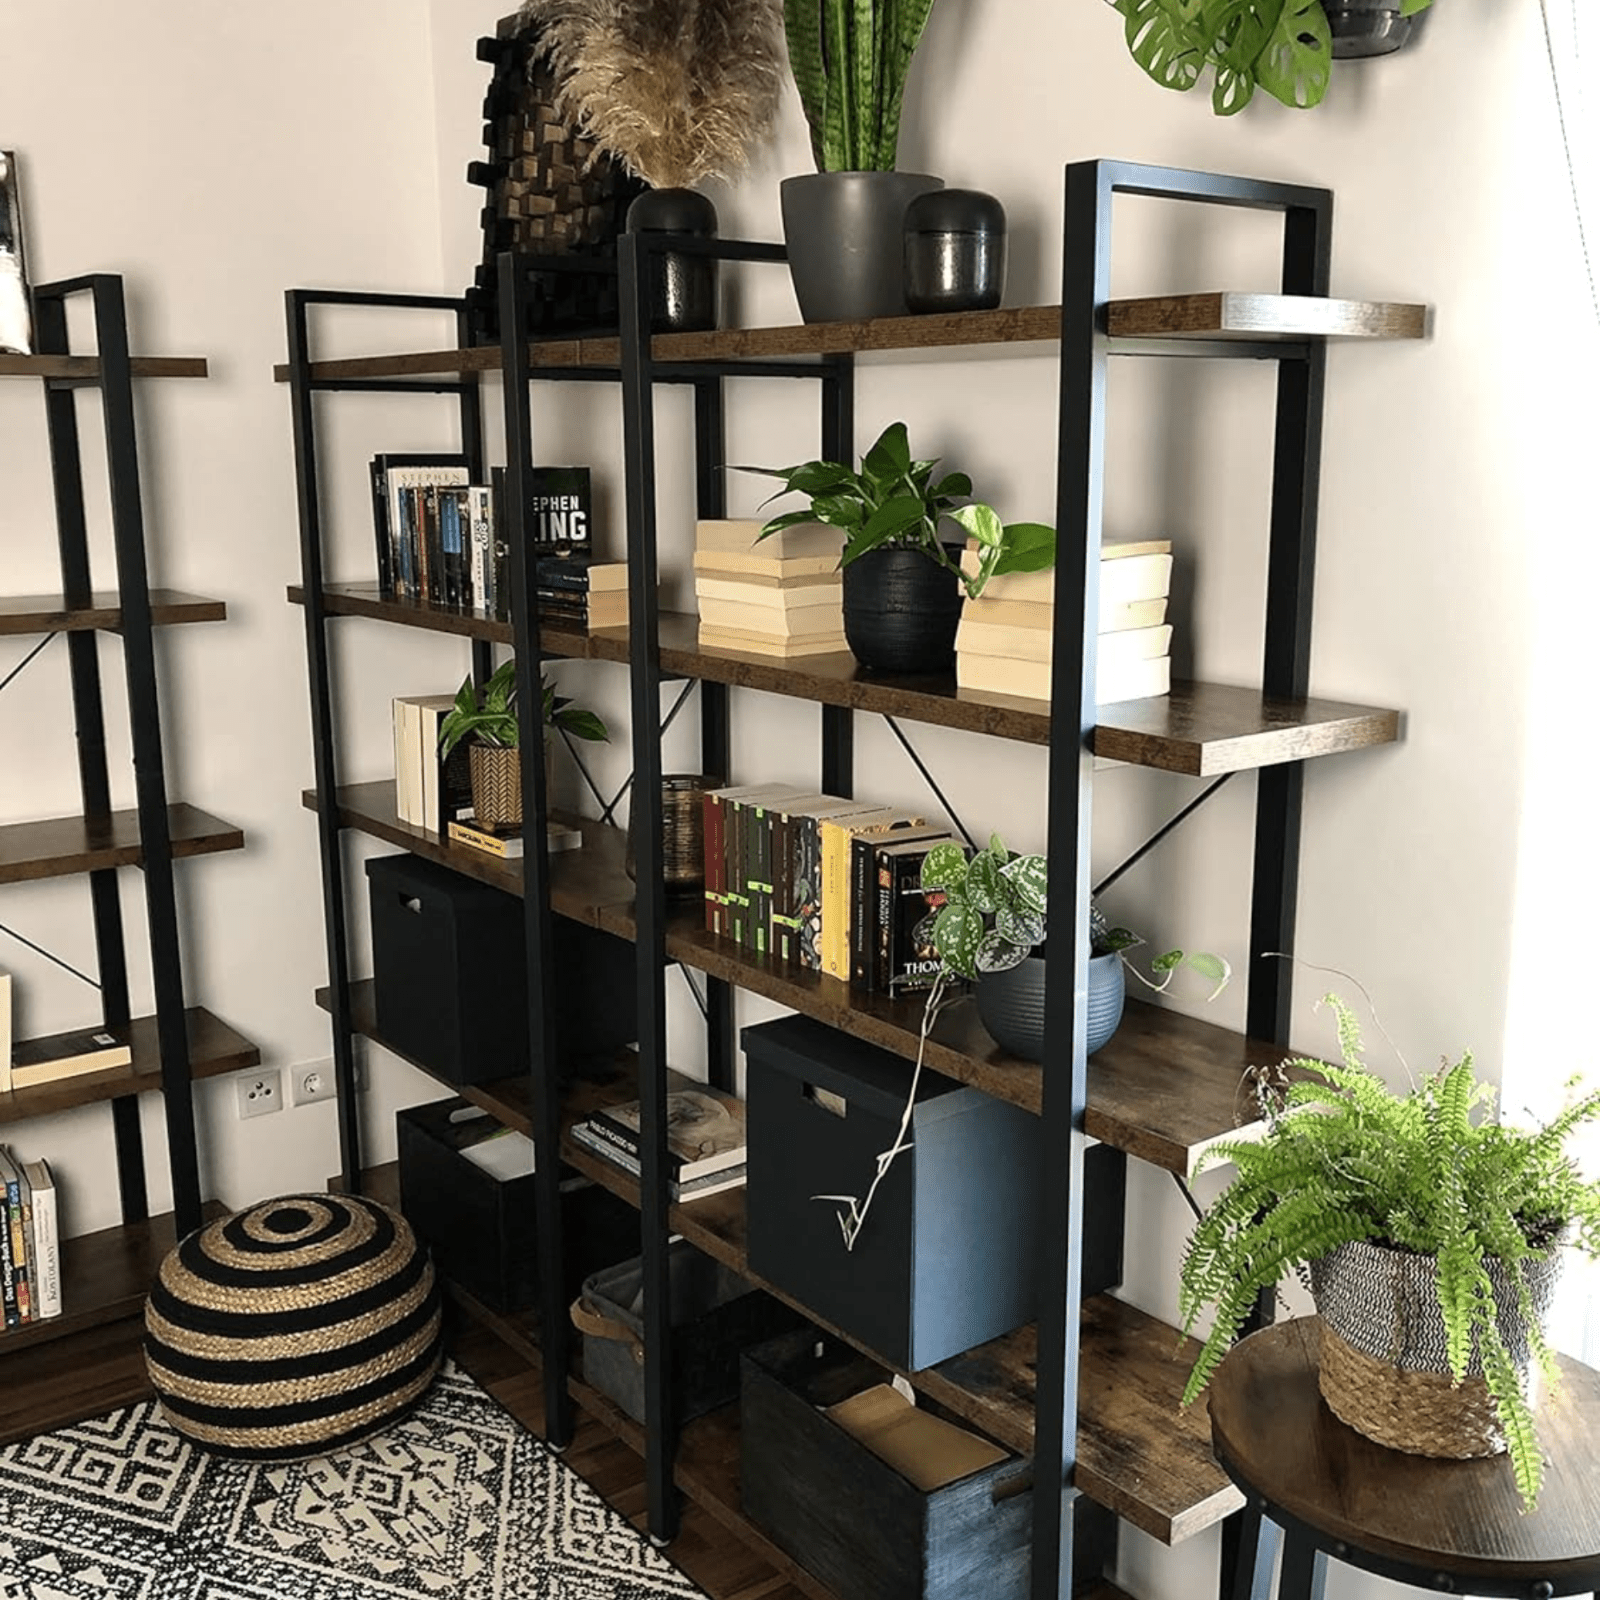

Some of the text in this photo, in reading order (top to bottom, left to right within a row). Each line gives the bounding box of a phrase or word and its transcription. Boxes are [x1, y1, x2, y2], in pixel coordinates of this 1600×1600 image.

[401, 473, 461, 481] STEPHEN
[533, 495, 580, 511] PHEN
[534, 511, 586, 542] ING
[904, 960, 944, 974] THOM
[1, 1242, 13, 1286] Design-Buch
[47, 1245, 57, 1301] KOSTOLANY
[5, 1287, 14, 1302] Das
